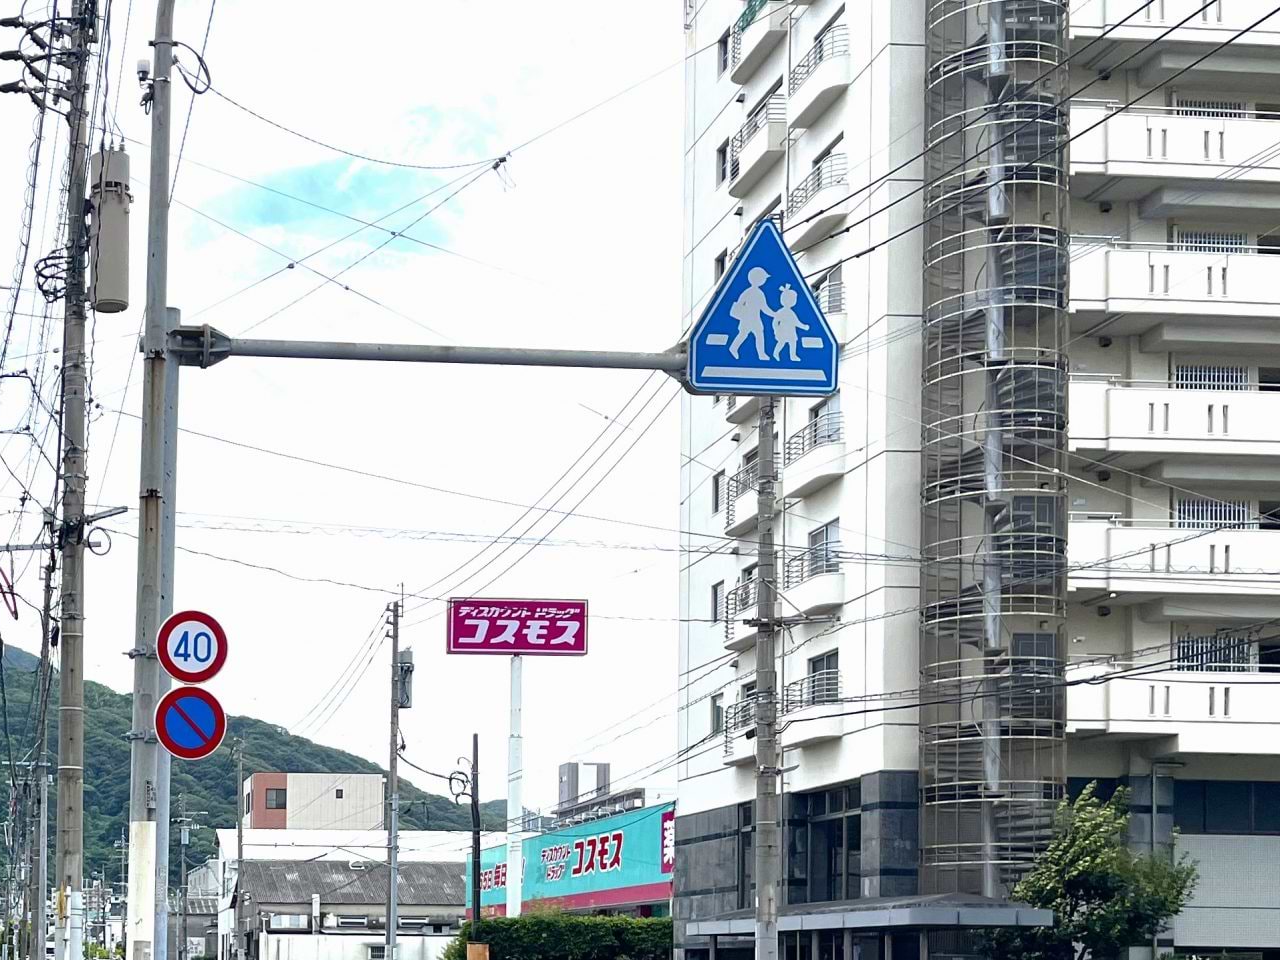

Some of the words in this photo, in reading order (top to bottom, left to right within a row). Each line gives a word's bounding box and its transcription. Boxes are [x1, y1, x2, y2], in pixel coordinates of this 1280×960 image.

[458, 606, 531, 618] ディスカウント
[534, 608, 580, 619] ドラッグ
[173, 631, 212, 663] 40
[458, 619, 581, 646] コスモス
[572, 831, 624, 877] コスモス
